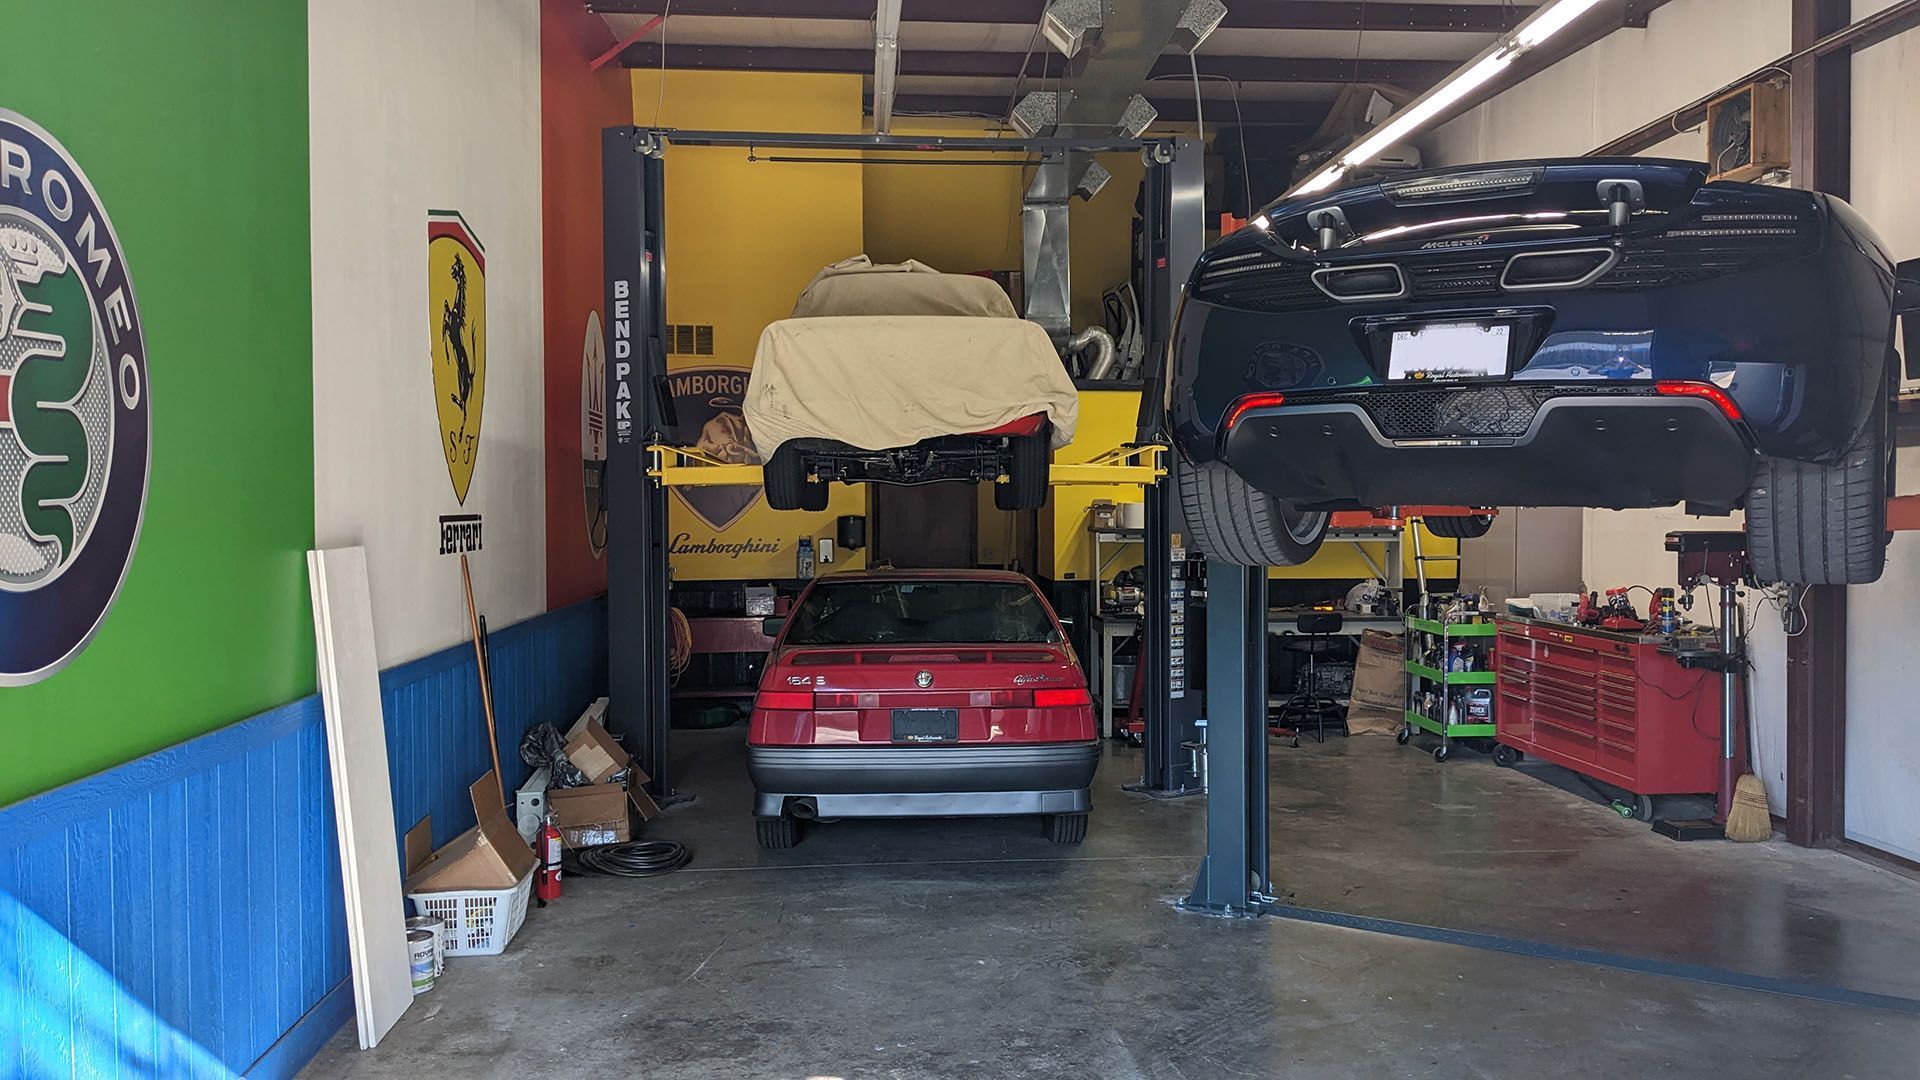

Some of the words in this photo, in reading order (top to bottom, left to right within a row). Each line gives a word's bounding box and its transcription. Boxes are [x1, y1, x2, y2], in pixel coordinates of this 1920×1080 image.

[0, 138, 140, 410] ROMEO
[614, 280, 631, 419] BENDPAK
[1397, 333, 1409, 341] DEC
[439, 514, 483, 555] Ferrari
[669, 533, 780, 558] Lamborghini
